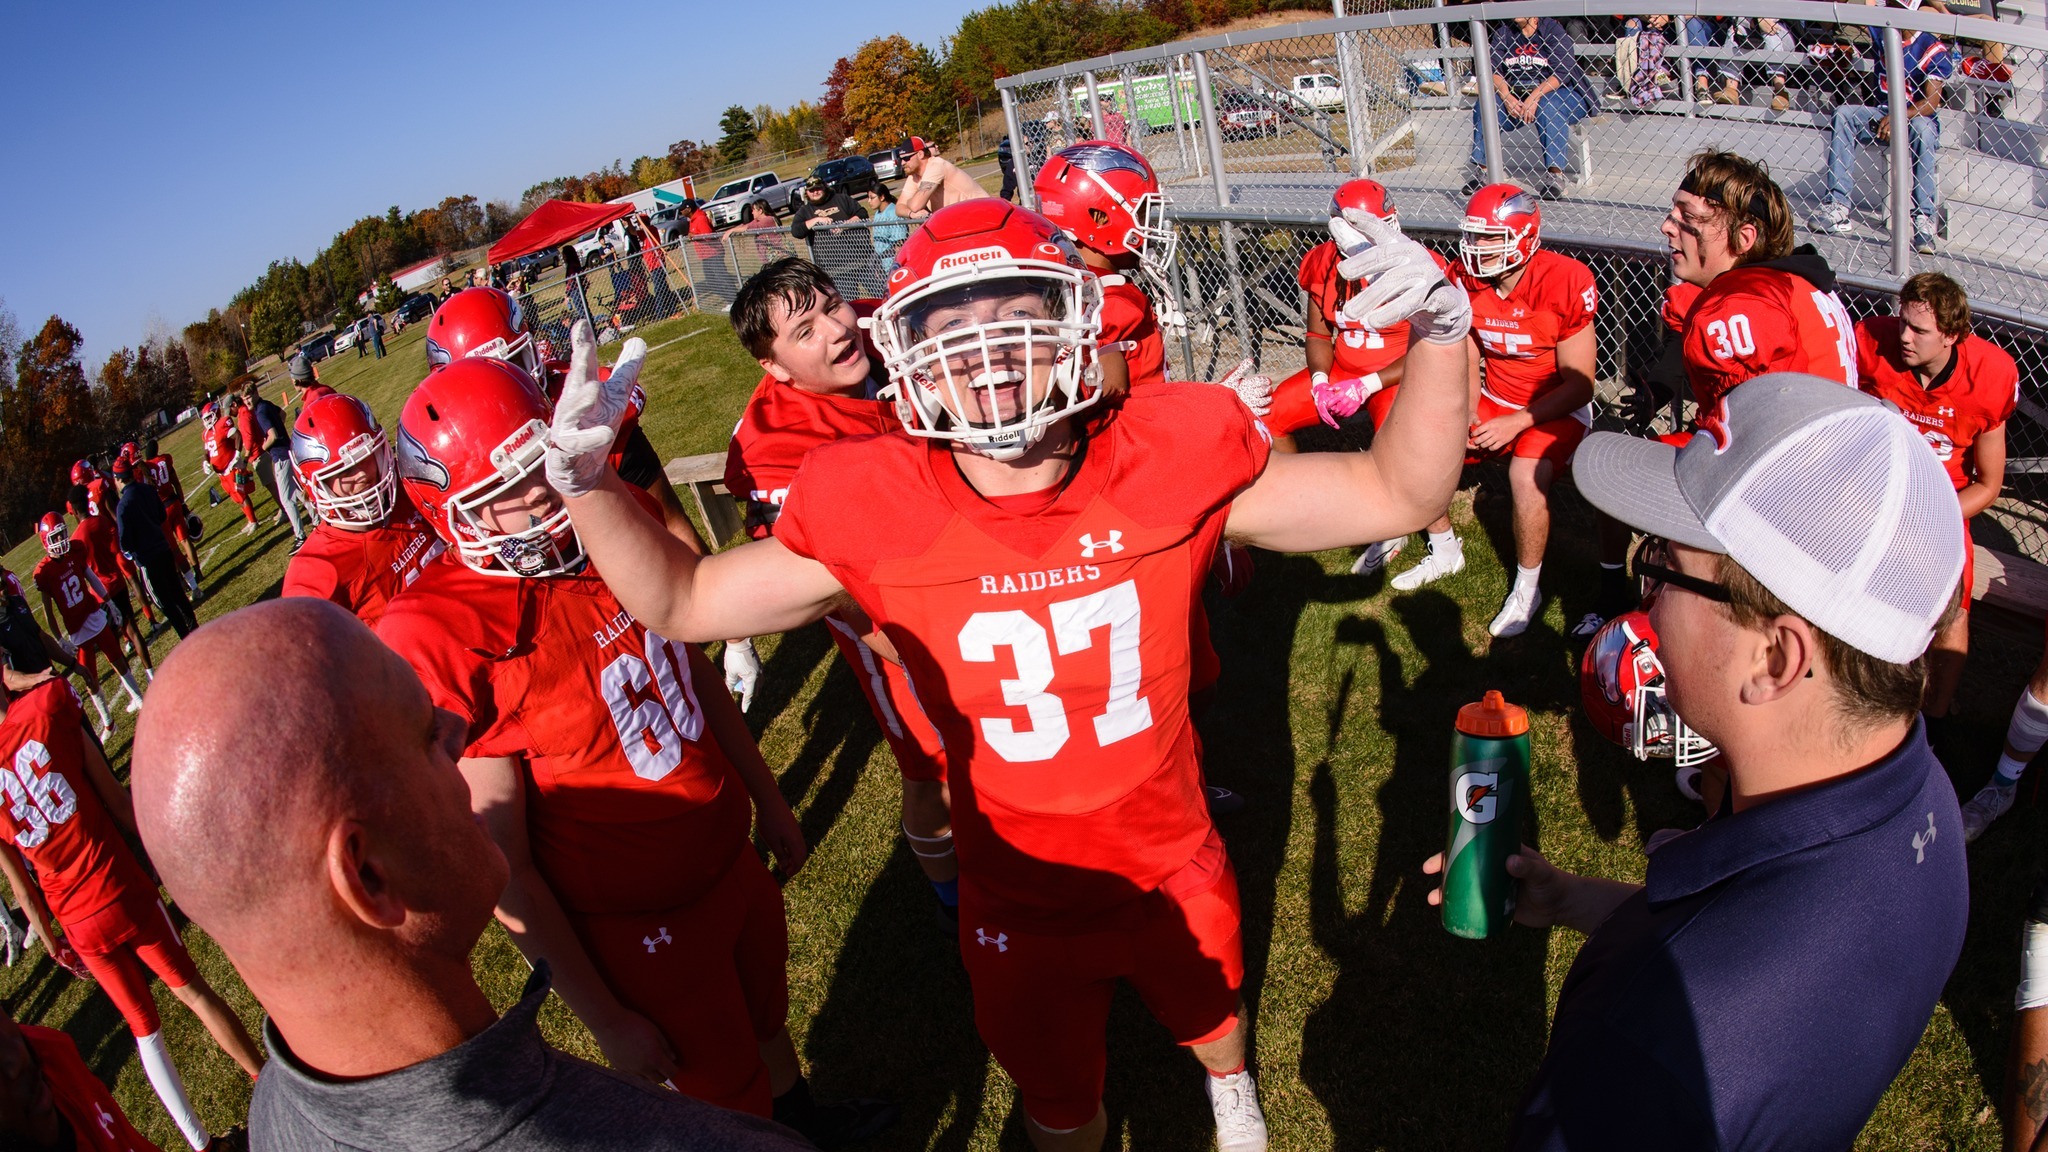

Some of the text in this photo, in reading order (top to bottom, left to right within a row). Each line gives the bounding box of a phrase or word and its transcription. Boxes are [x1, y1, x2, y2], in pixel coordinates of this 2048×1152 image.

[1519, 55, 1532, 65] 80
[940, 250, 1002, 269] Riddell
[1485, 317, 1520, 329] RAIDERS
[1707, 313, 1756, 359] 30
[473, 341, 498, 357] Riddell
[911, 369, 937, 392] dell
[1902, 408, 1944, 428] RAIDERS
[503, 426, 535, 456] Riddell
[987, 430, 1020, 443] Riddell
[391, 532, 427, 574] RAIDERS
[61, 574, 84, 609] 12
[979, 564, 1101, 594] RAIDERS
[593, 609, 636, 649] RAID
[957, 579, 1153, 763] 37
[601, 629, 705, 781] 60
[0, 739, 77, 848] 36
[1455, 771, 1499, 825] G
